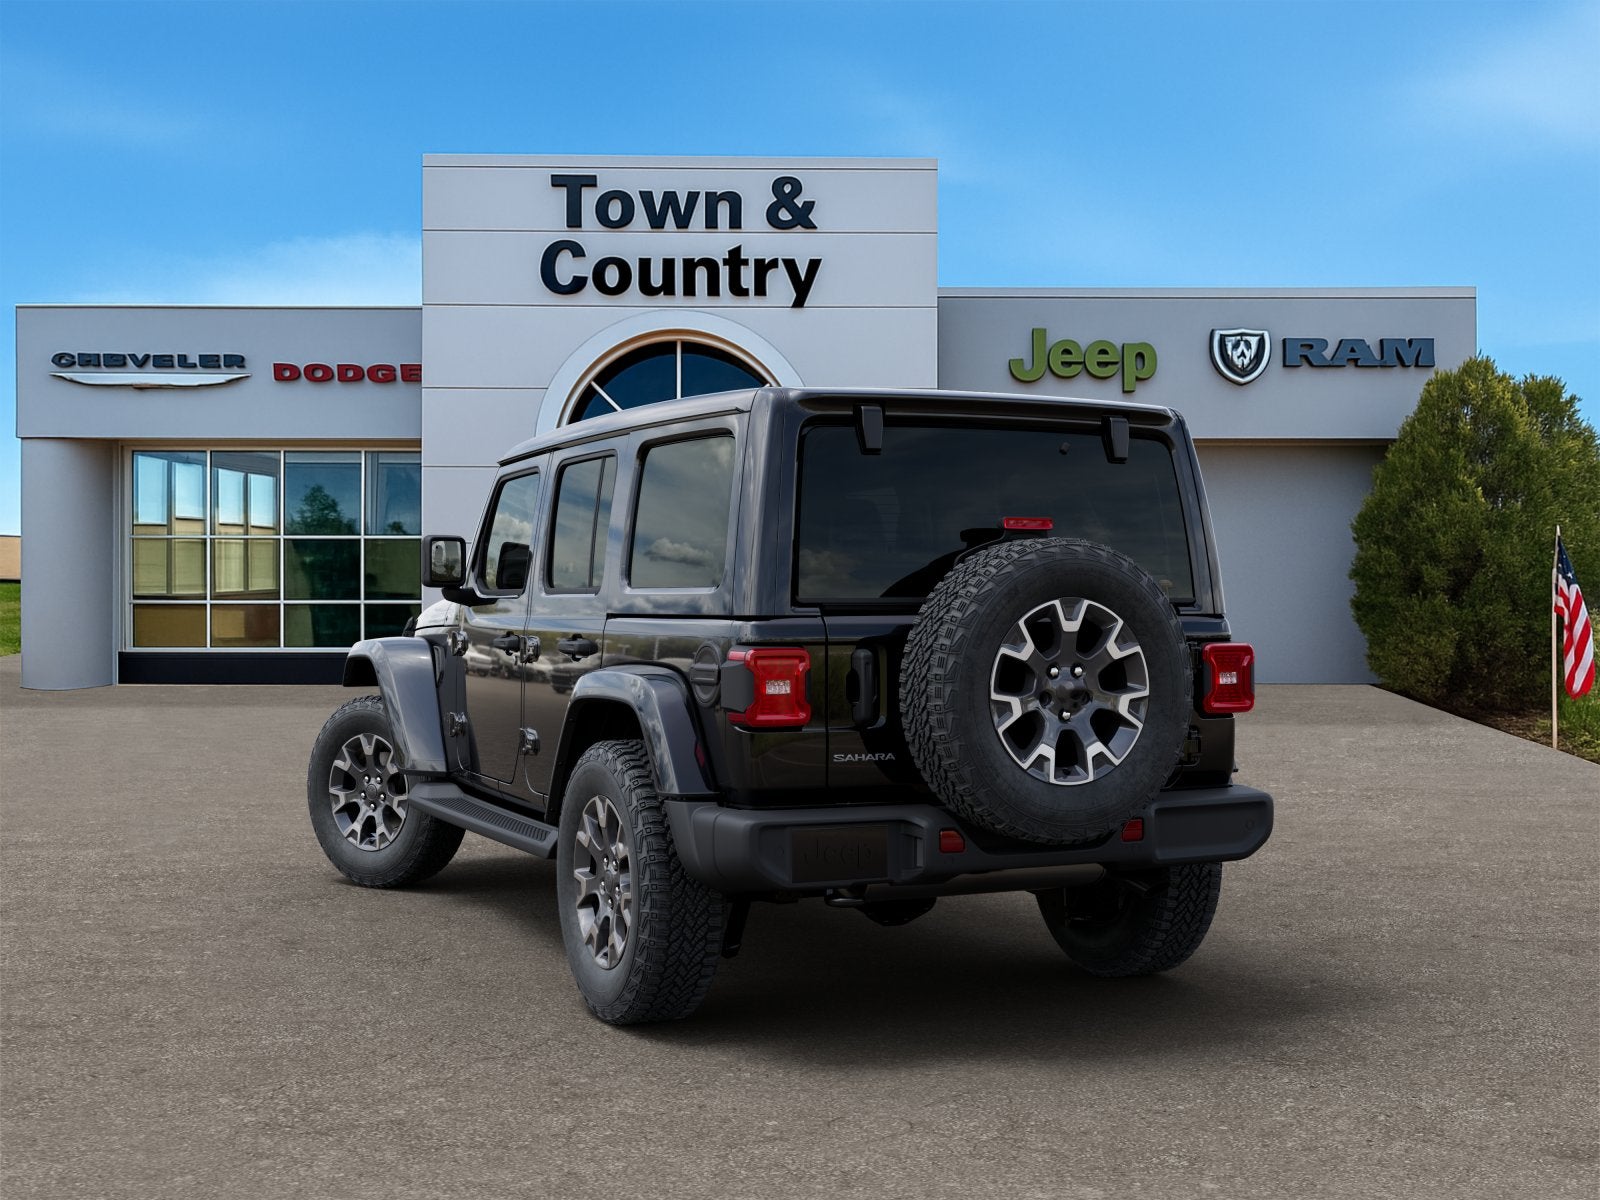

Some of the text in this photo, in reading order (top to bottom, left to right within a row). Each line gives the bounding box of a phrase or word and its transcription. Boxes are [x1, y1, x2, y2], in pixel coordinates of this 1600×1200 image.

[550, 174, 818, 230] Town &
[540, 239, 823, 308] Country
[273, 362, 422, 383] DODGE
[1009, 327, 1158, 393] Jeep
[1282, 337, 1436, 367] RAM
[832, 752, 896, 763] SAHARA
